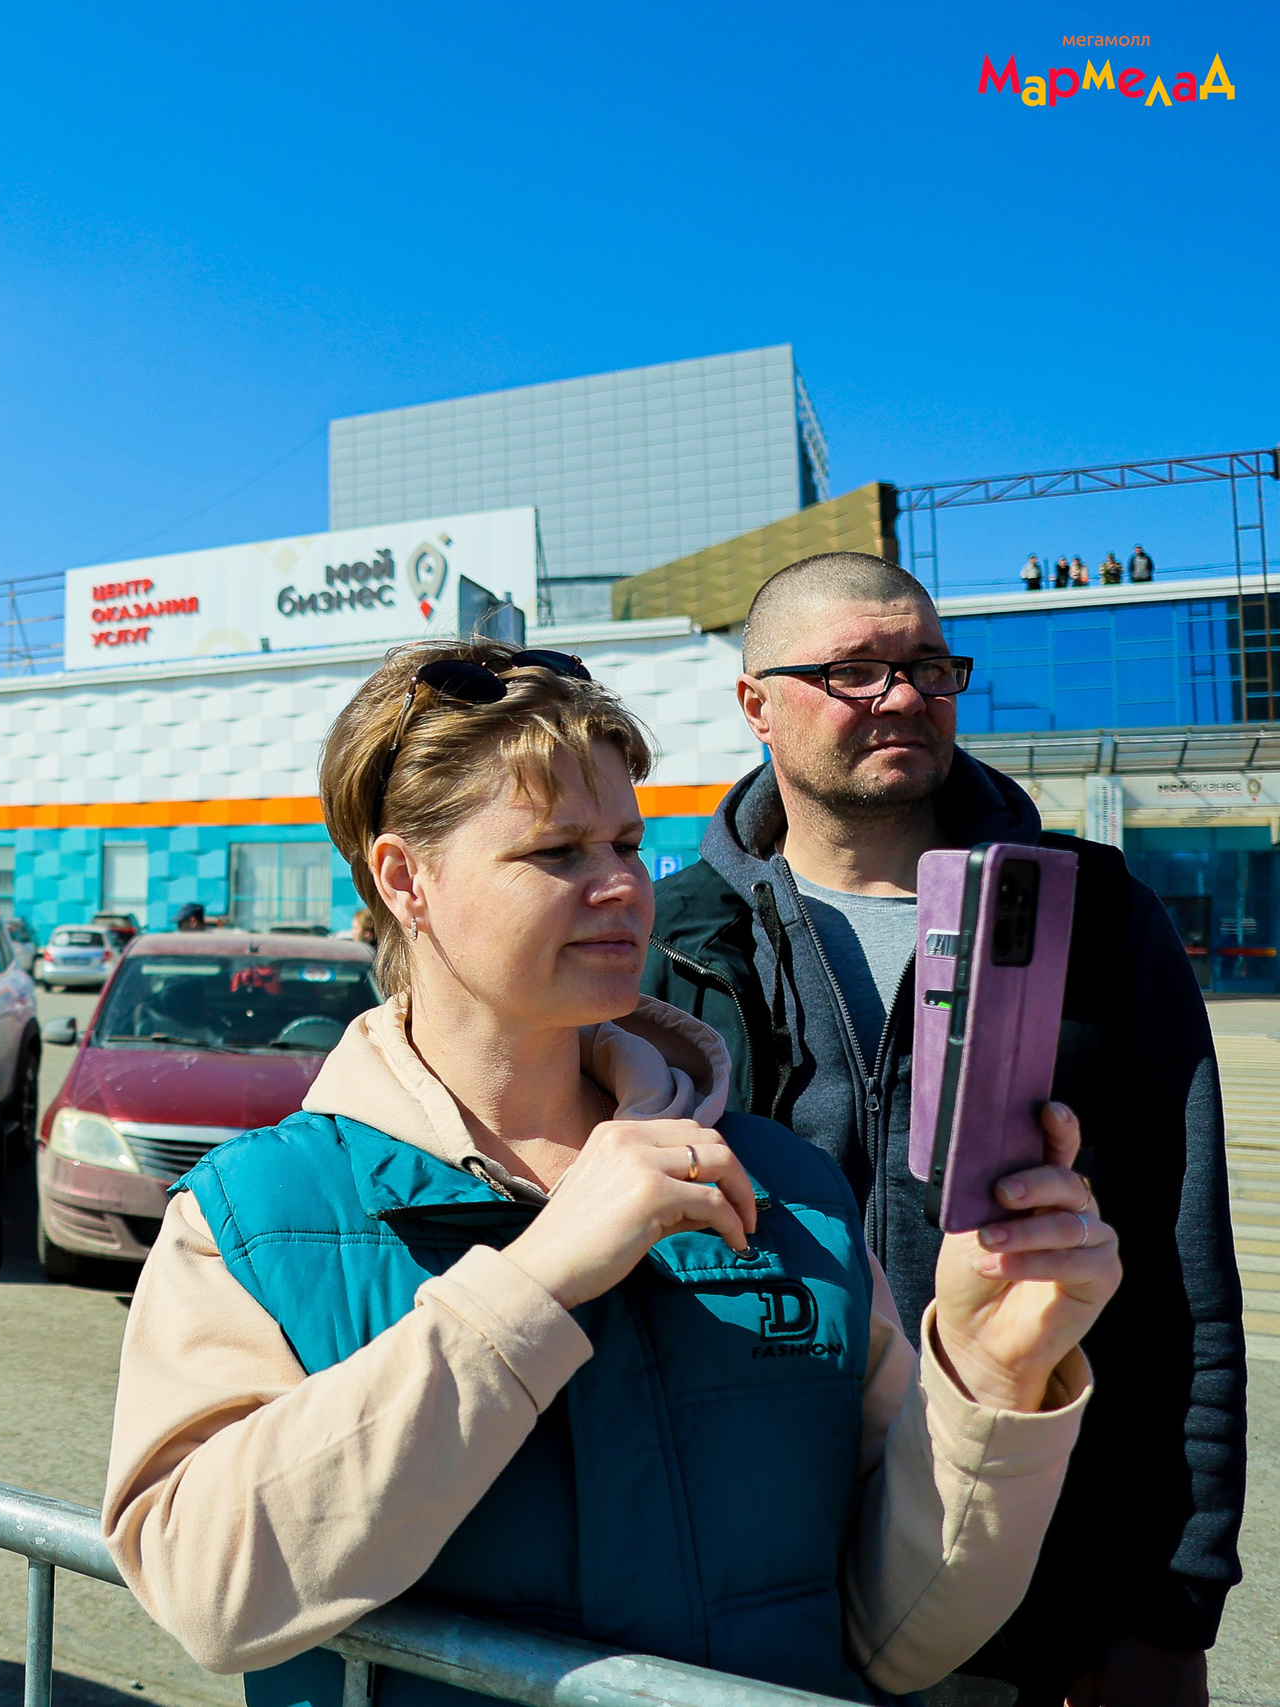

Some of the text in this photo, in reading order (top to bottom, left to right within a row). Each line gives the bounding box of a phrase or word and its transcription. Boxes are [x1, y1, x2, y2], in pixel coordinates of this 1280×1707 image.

[92, 579, 154, 602] ЦЕНТР
[91, 596, 199, 624] ОКАЗАНИЯ
[91, 627, 151, 648] УСЛУГ
[751, 1342, 842, 1360] FASHION
